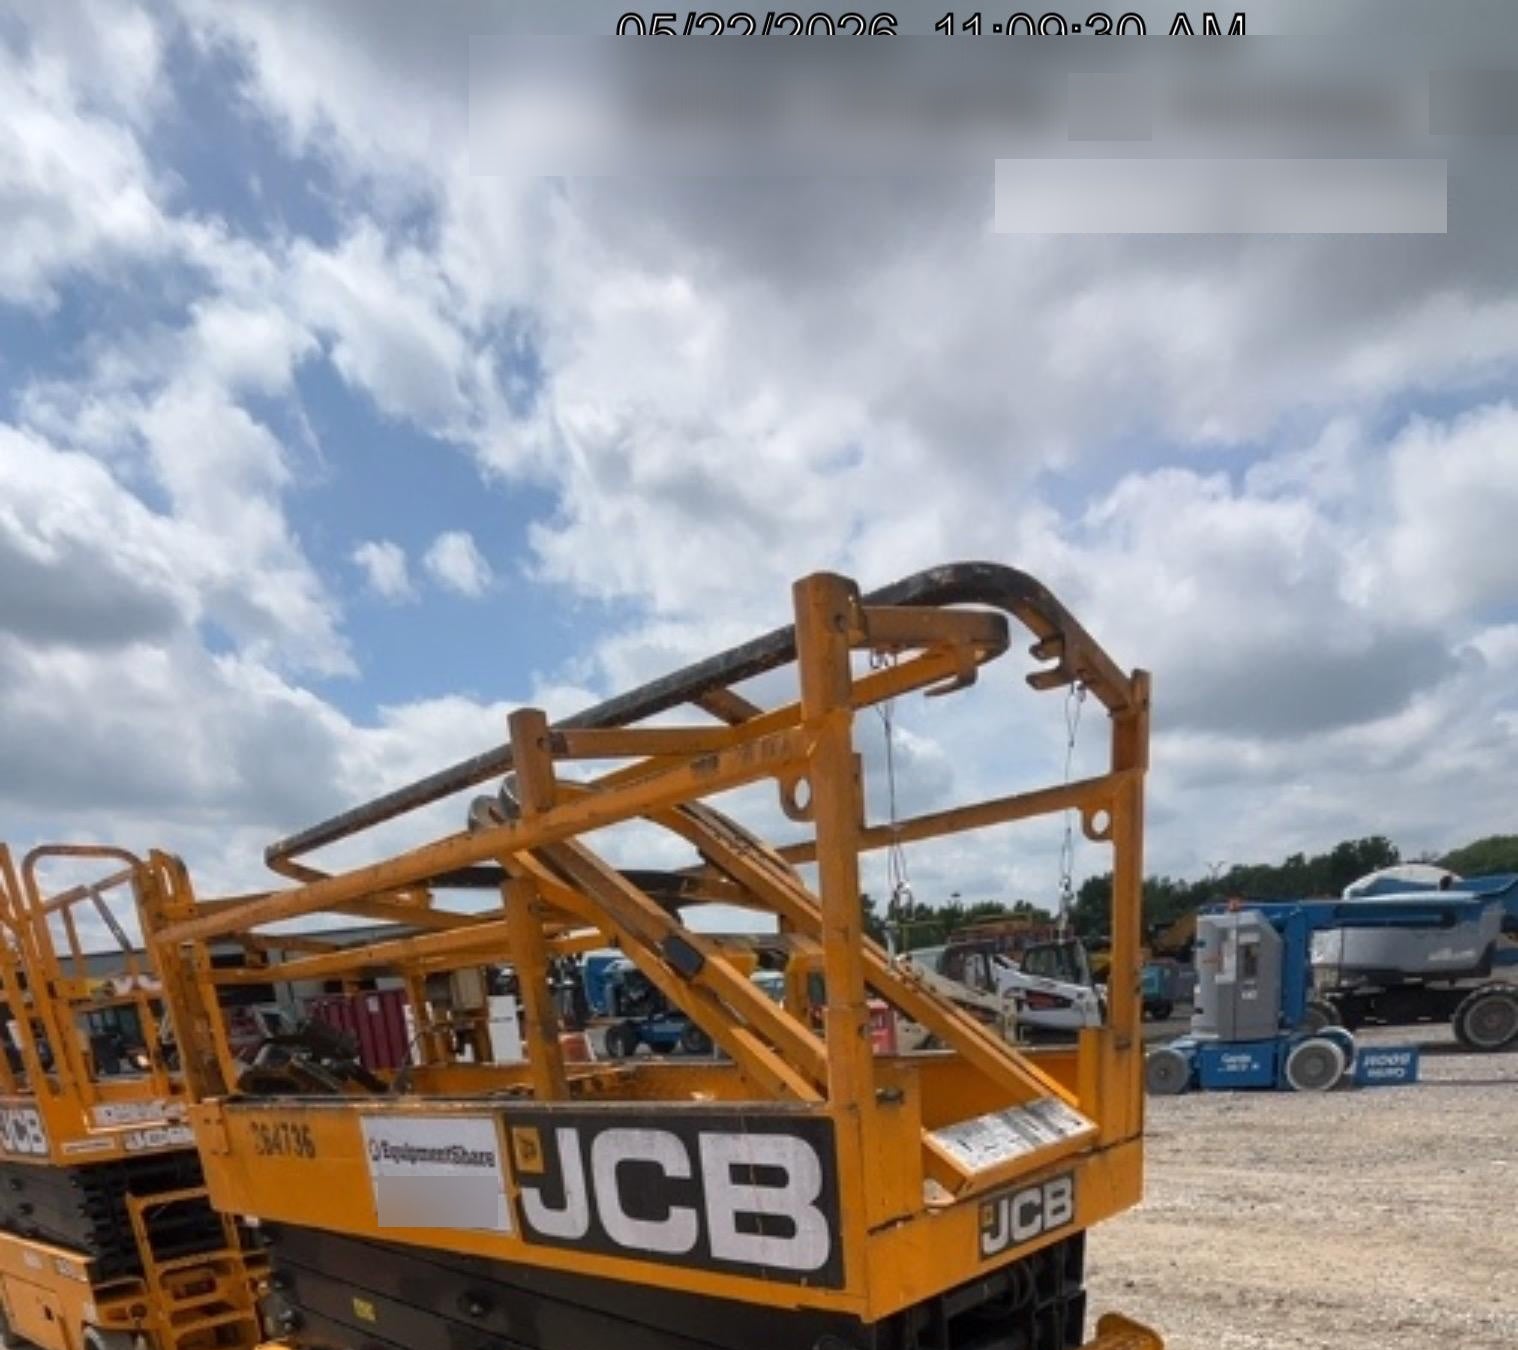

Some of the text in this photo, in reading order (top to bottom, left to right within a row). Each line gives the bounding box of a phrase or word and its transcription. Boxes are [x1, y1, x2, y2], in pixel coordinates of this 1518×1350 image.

[381, 1138, 496, 1168] EquipmentShare
[521, 1126, 832, 1272] JCB
[982, 1177, 1073, 1255] JCB
